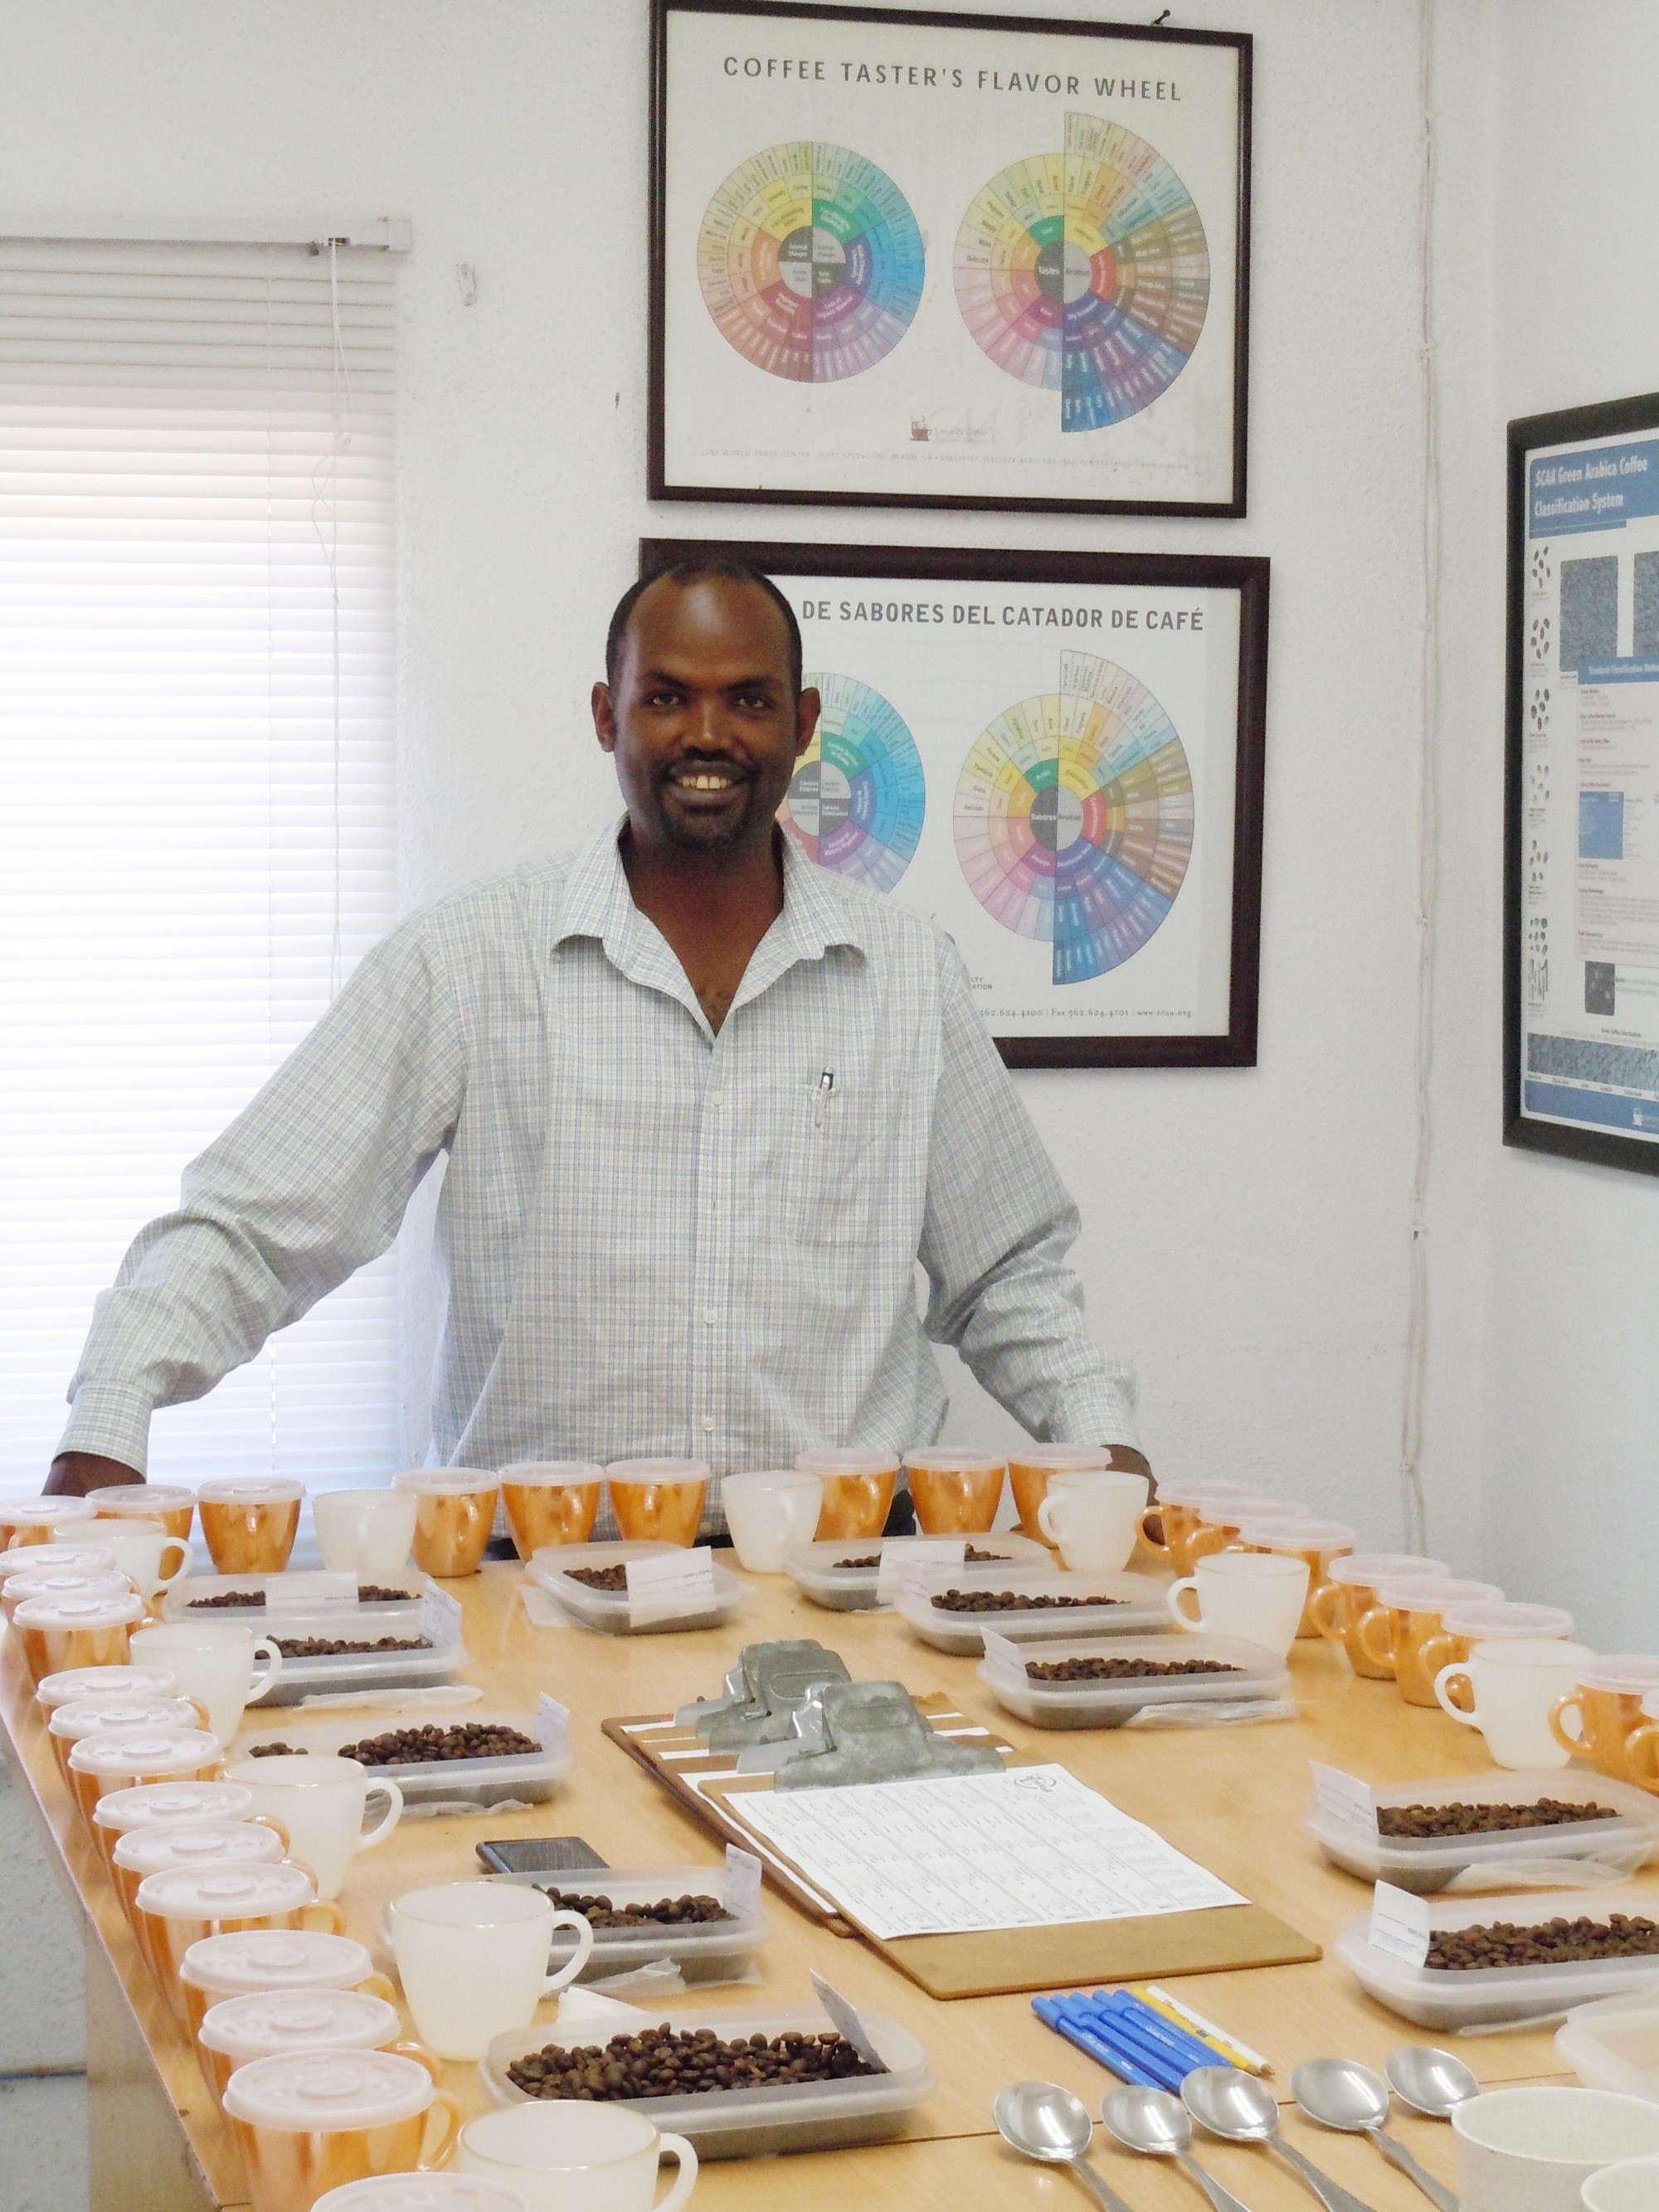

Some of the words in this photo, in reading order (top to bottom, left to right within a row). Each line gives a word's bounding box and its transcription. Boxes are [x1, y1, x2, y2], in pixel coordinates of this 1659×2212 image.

[723, 56, 825, 80] COFFEE
[841, 62, 963, 88] TASTER'S
[978, 71, 1079, 95] FLAVOR
[1095, 77, 1181, 101] WHEEL
[1559, 466, 1582, 483] Green
[1585, 460, 1617, 479] Arabica
[1620, 456, 1647, 475] Coffee
[1535, 496, 1589, 517] Classification
[1592, 492, 1623, 514] System
[803, 601, 830, 621] DE
[839, 601, 944, 624] SABORES
[952, 605, 995, 625] DEL
[1002, 606, 1102, 628] CATADOR
[1112, 610, 1138, 629] DE
[1146, 607, 1204, 631] CAFÉ
